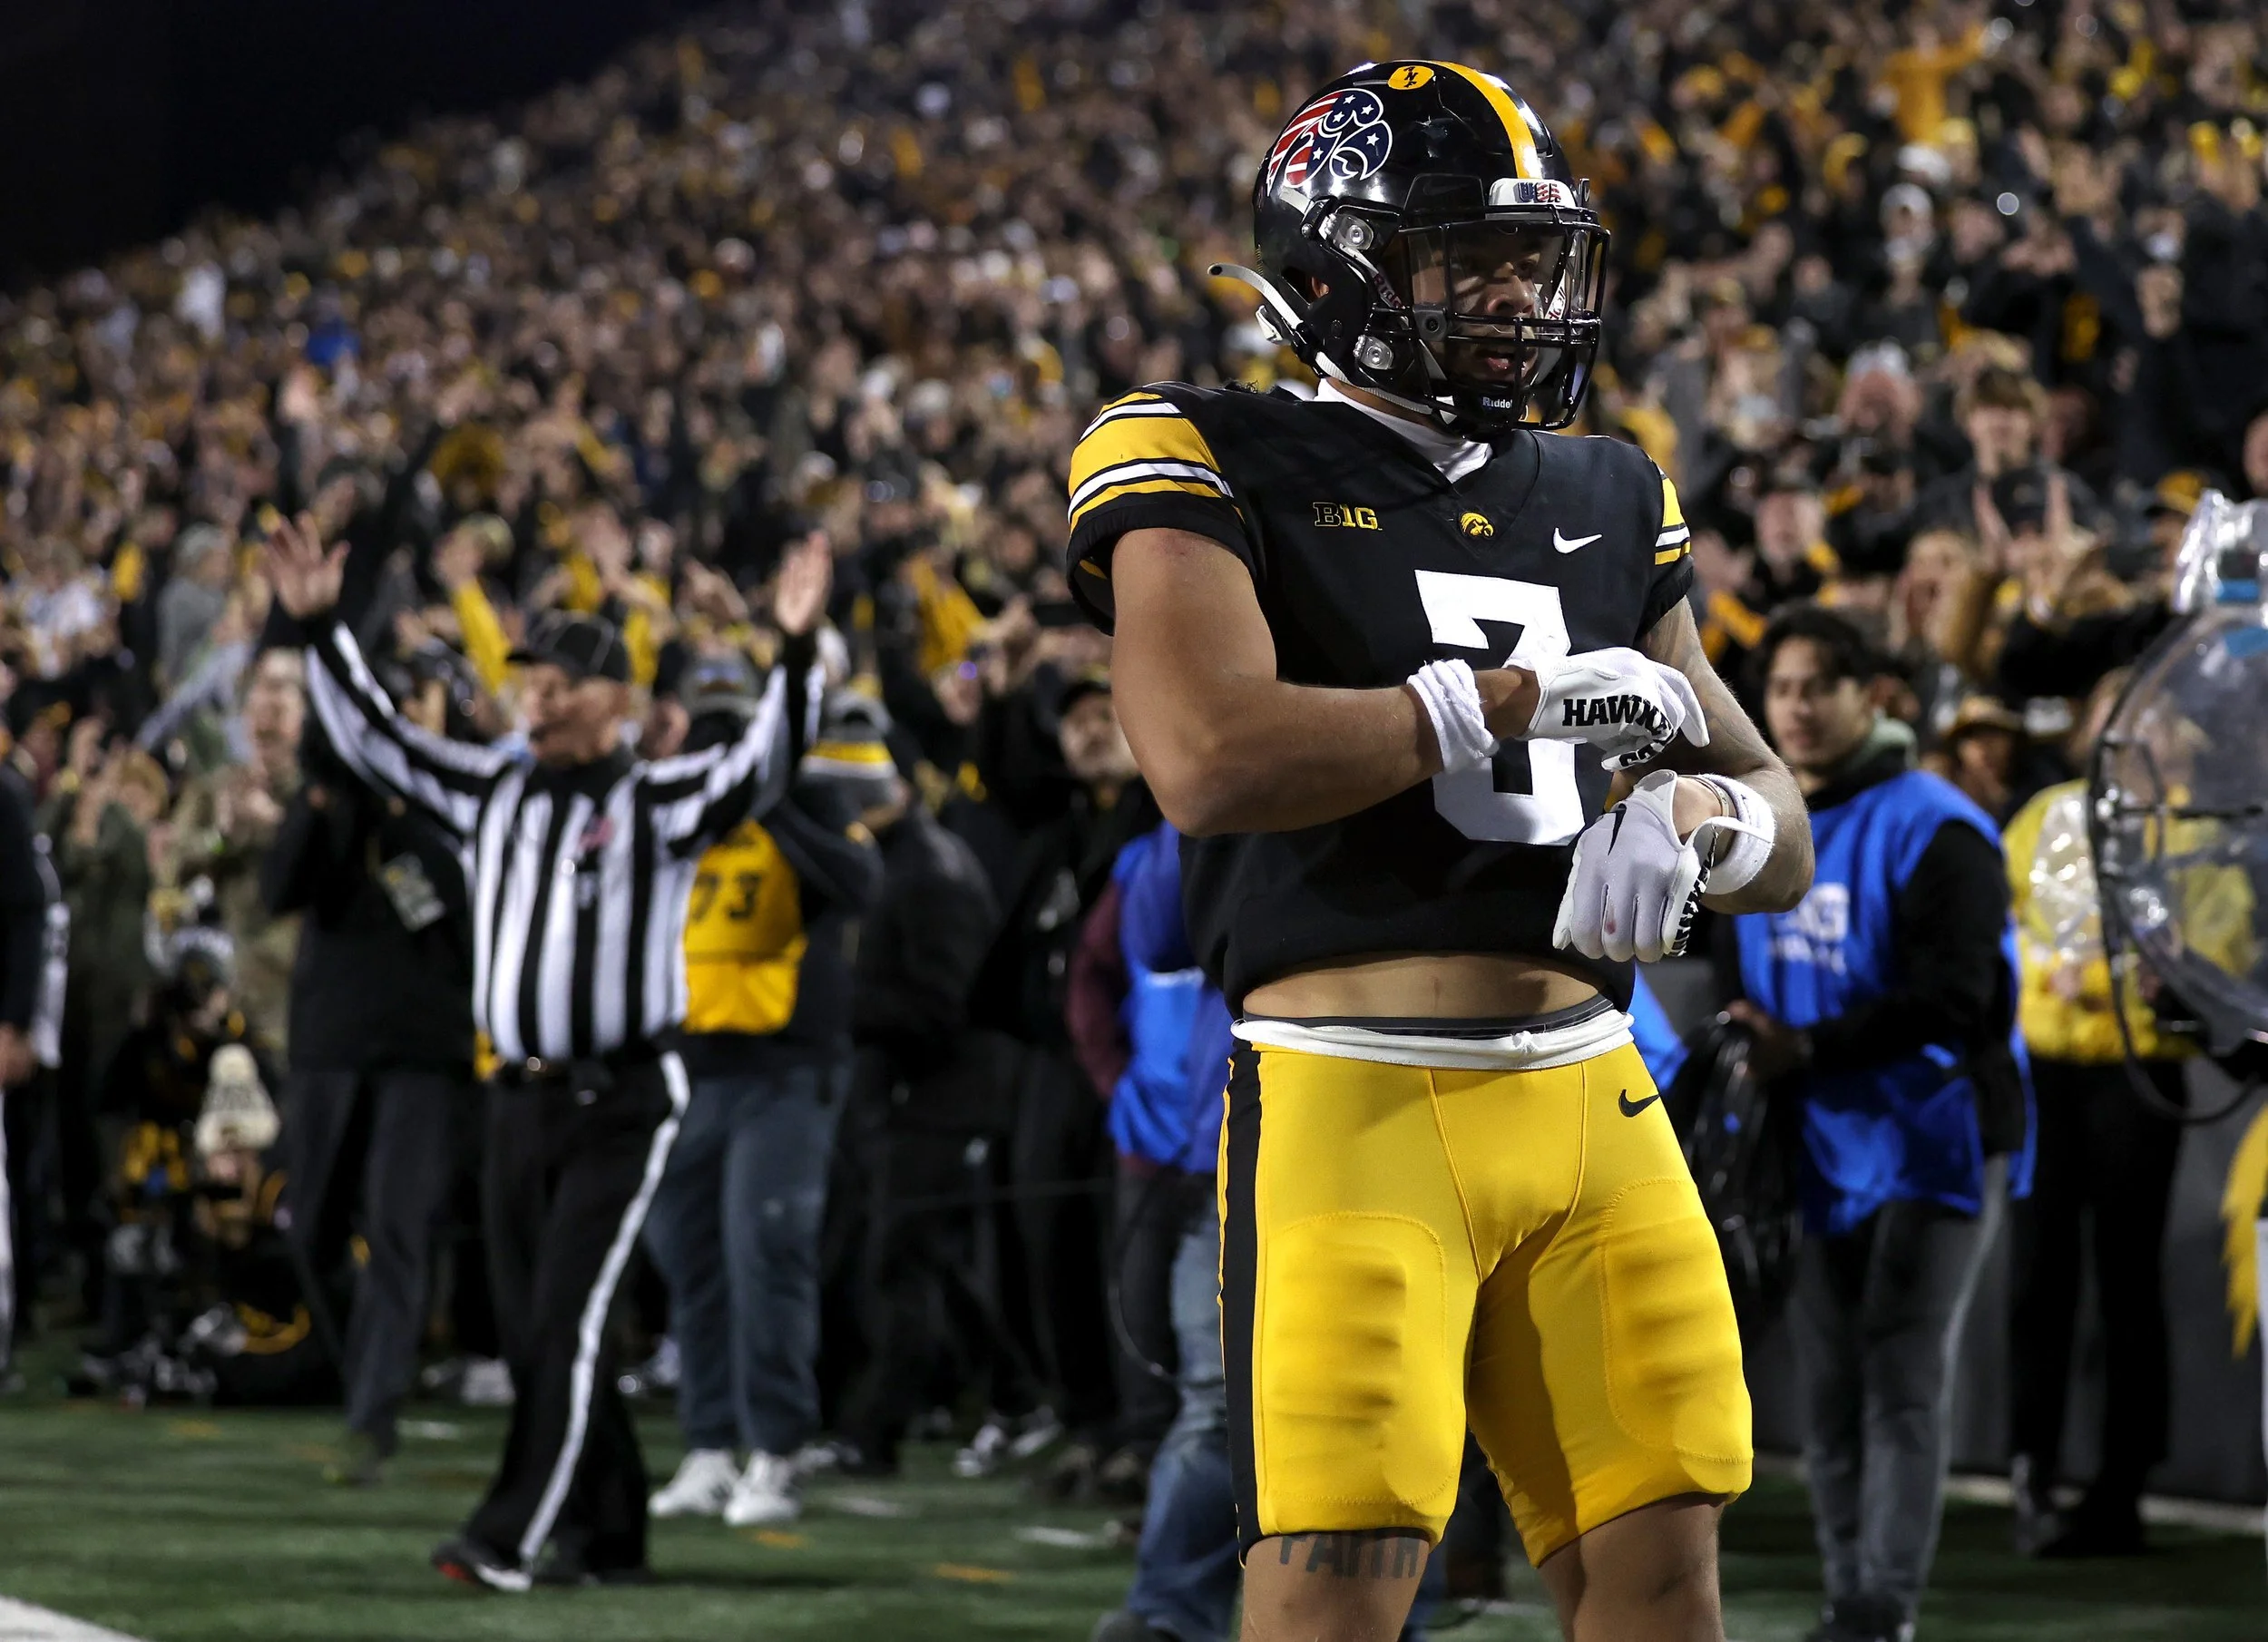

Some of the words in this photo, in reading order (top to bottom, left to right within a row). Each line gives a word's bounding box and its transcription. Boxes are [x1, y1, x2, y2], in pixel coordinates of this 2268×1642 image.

[1482, 396, 1513, 408] Riddel
[1414, 569, 1586, 846] 3
[1279, 1531, 1422, 1579] FAITH
